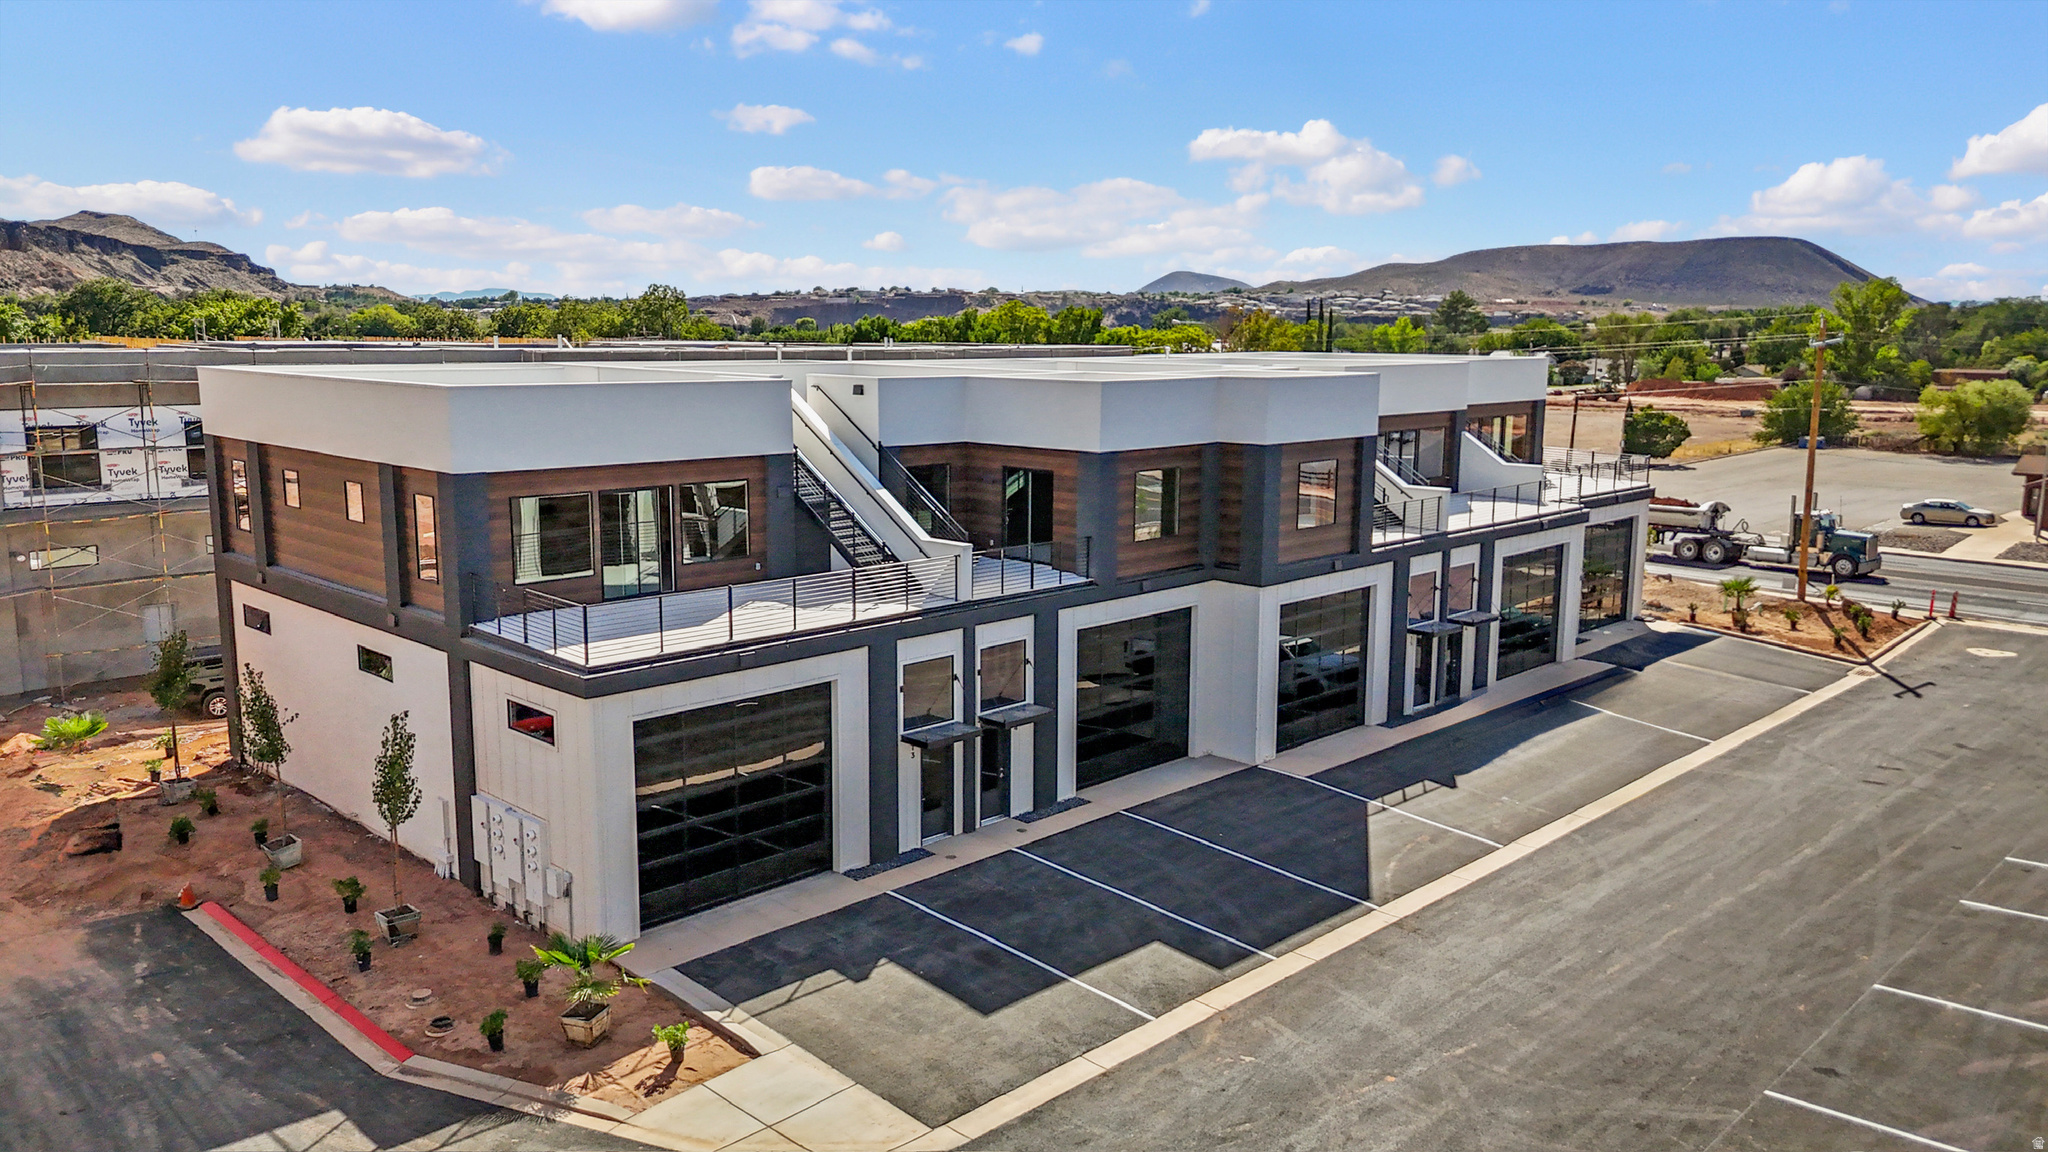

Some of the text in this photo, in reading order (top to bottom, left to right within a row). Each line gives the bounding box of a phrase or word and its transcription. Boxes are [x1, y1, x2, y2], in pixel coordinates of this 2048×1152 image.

[128, 417, 158, 428] Tyvek
[107, 468, 138, 478] Tyvek
[158, 464, 188, 475] Tyvek
